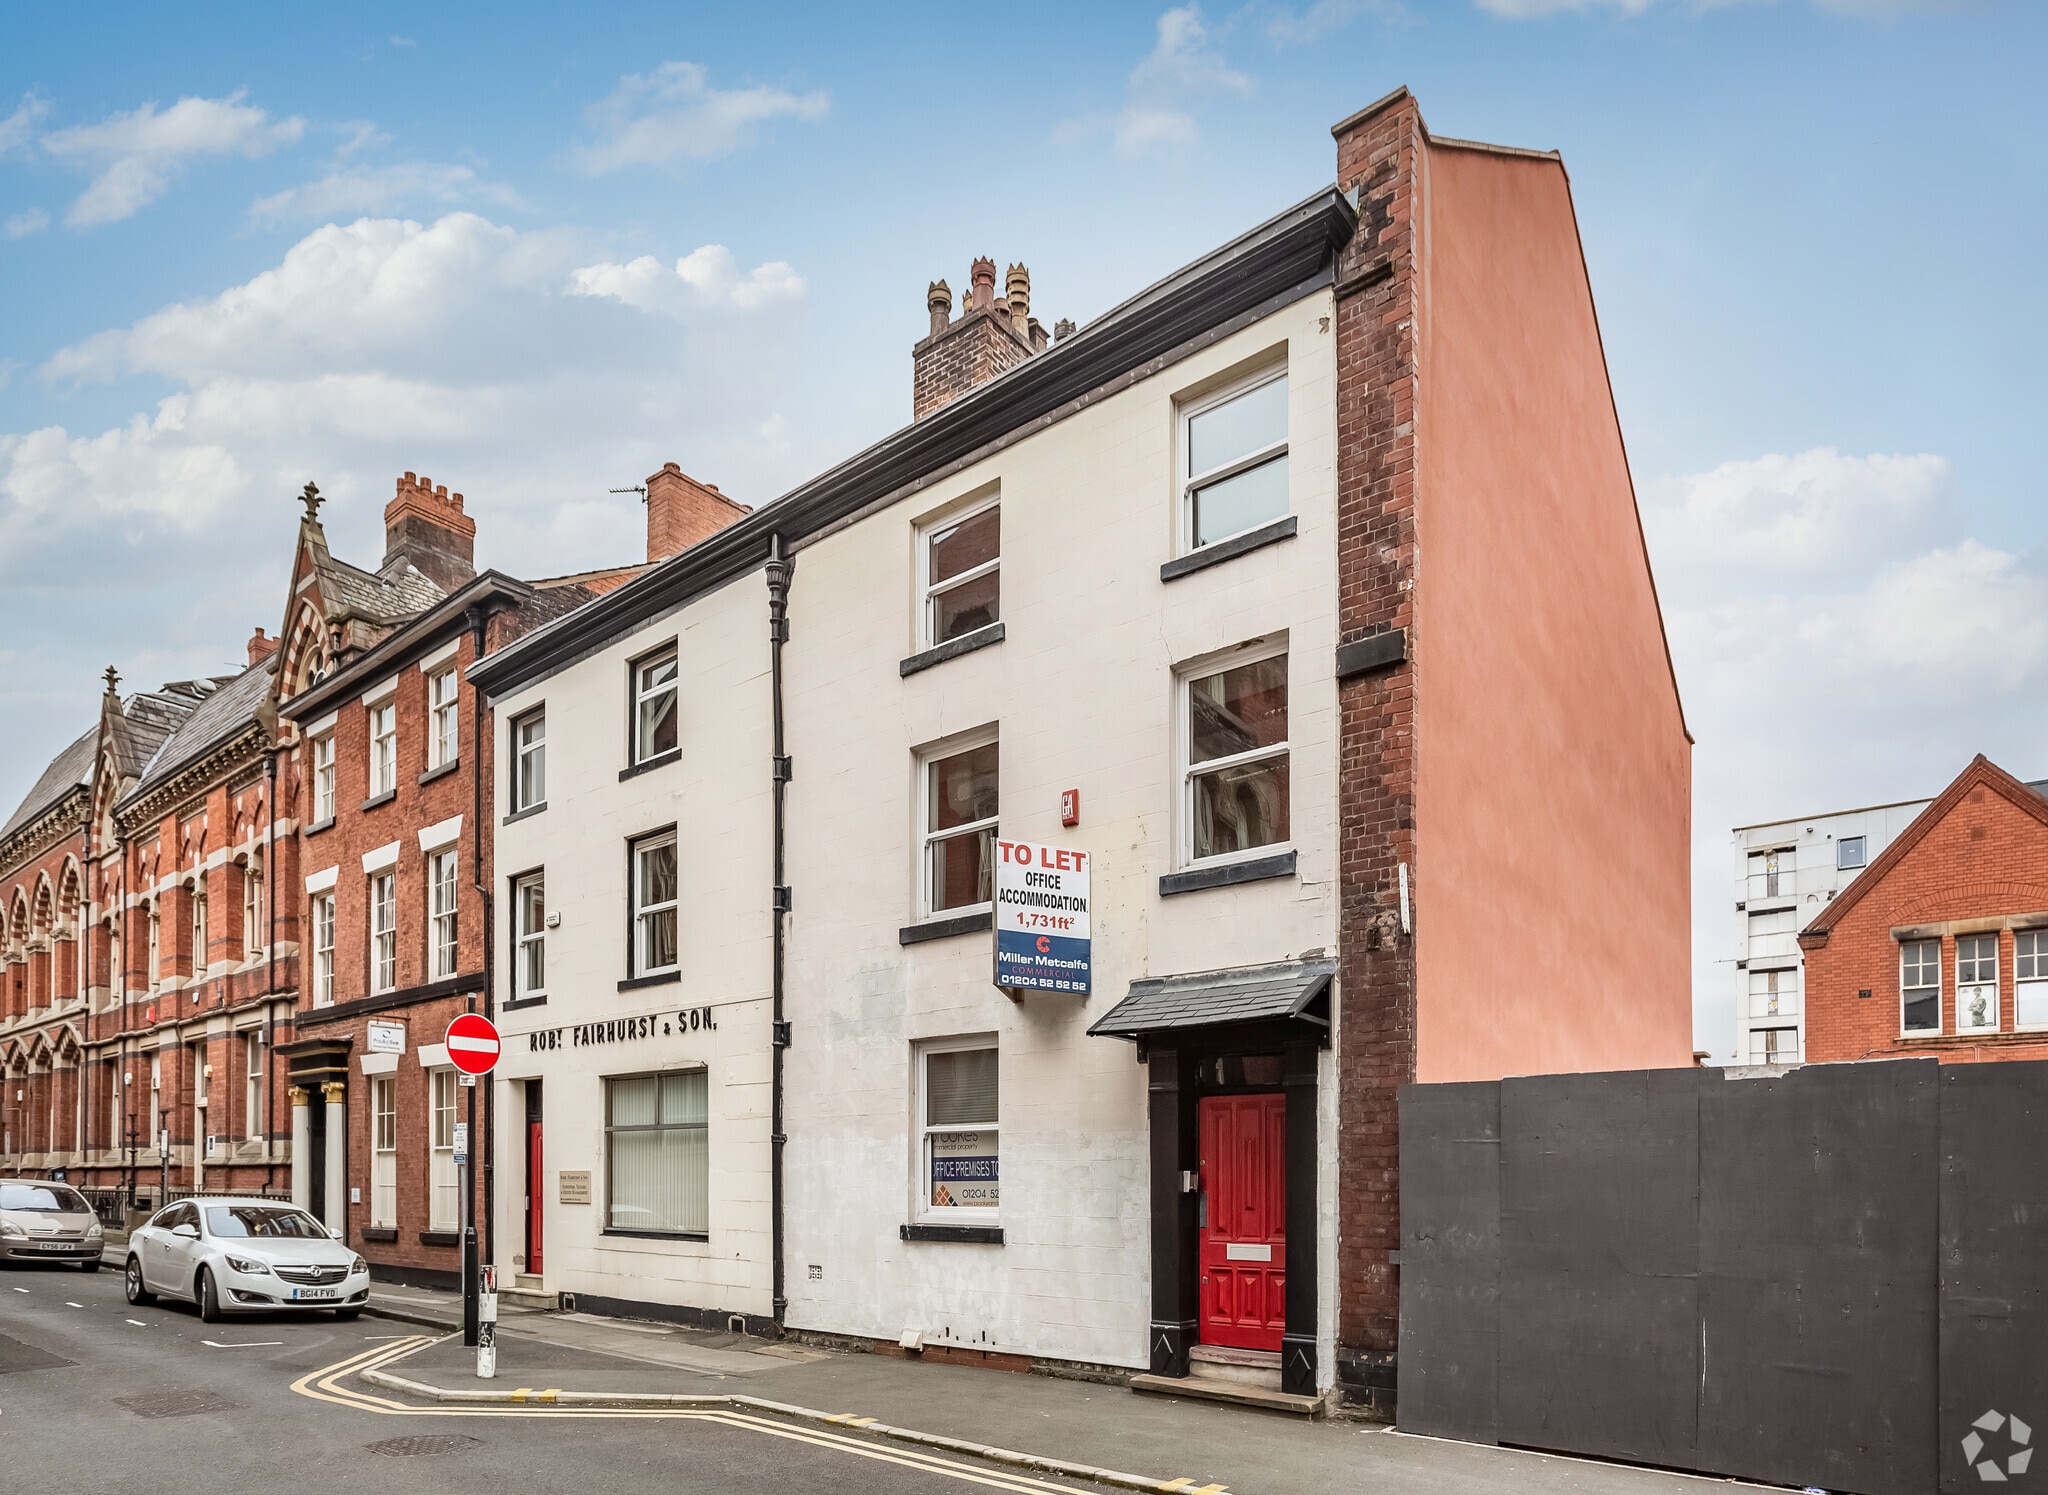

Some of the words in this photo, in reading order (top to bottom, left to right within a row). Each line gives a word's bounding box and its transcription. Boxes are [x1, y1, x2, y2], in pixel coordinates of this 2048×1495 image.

[998, 841, 1032, 865] TO
[1041, 847, 1086, 872] LET
[1025, 871, 1061, 890] OFFICE
[999, 951, 1034, 965] Miller
[1035, 955, 1088, 971] Metcalfe
[1011, 965, 1076, 979] COMMERCIAL
[1001, 974, 1037, 987] 01204
[1039, 978, 1054, 989] 52
[1055, 979, 1071, 990] 52
[1072, 980, 1087, 991] 52
[573, 1014, 657, 1048] FAIRHURST
[663, 1022, 671, 1036] &
[955, 1160, 990, 1177] PREMISES
[962, 1188, 986, 1199] 01204
[990, 1188, 999, 1199] 52
[300, 1289, 319, 1298] BG14
[320, 1289, 336, 1298] FVD
